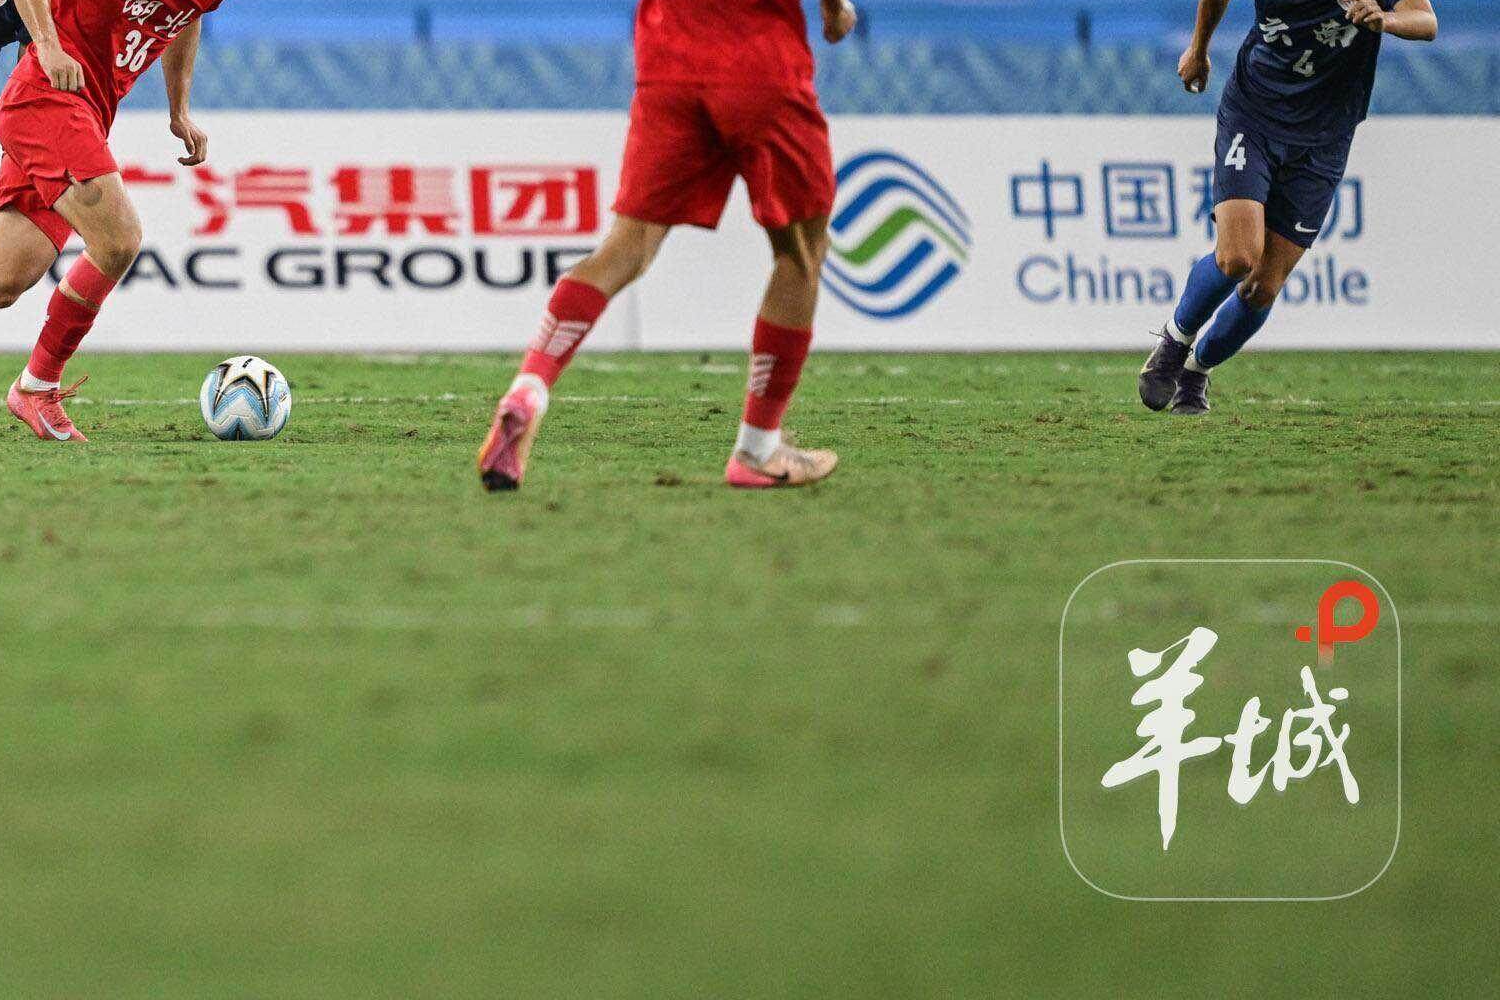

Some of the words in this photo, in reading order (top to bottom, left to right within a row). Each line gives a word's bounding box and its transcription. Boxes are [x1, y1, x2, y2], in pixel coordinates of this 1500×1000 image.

[115, 29, 157, 72] 36
[1224, 133, 1247, 171] 4
[121, 164, 599, 236] 汽集团
[1018, 255, 1175, 303] China
